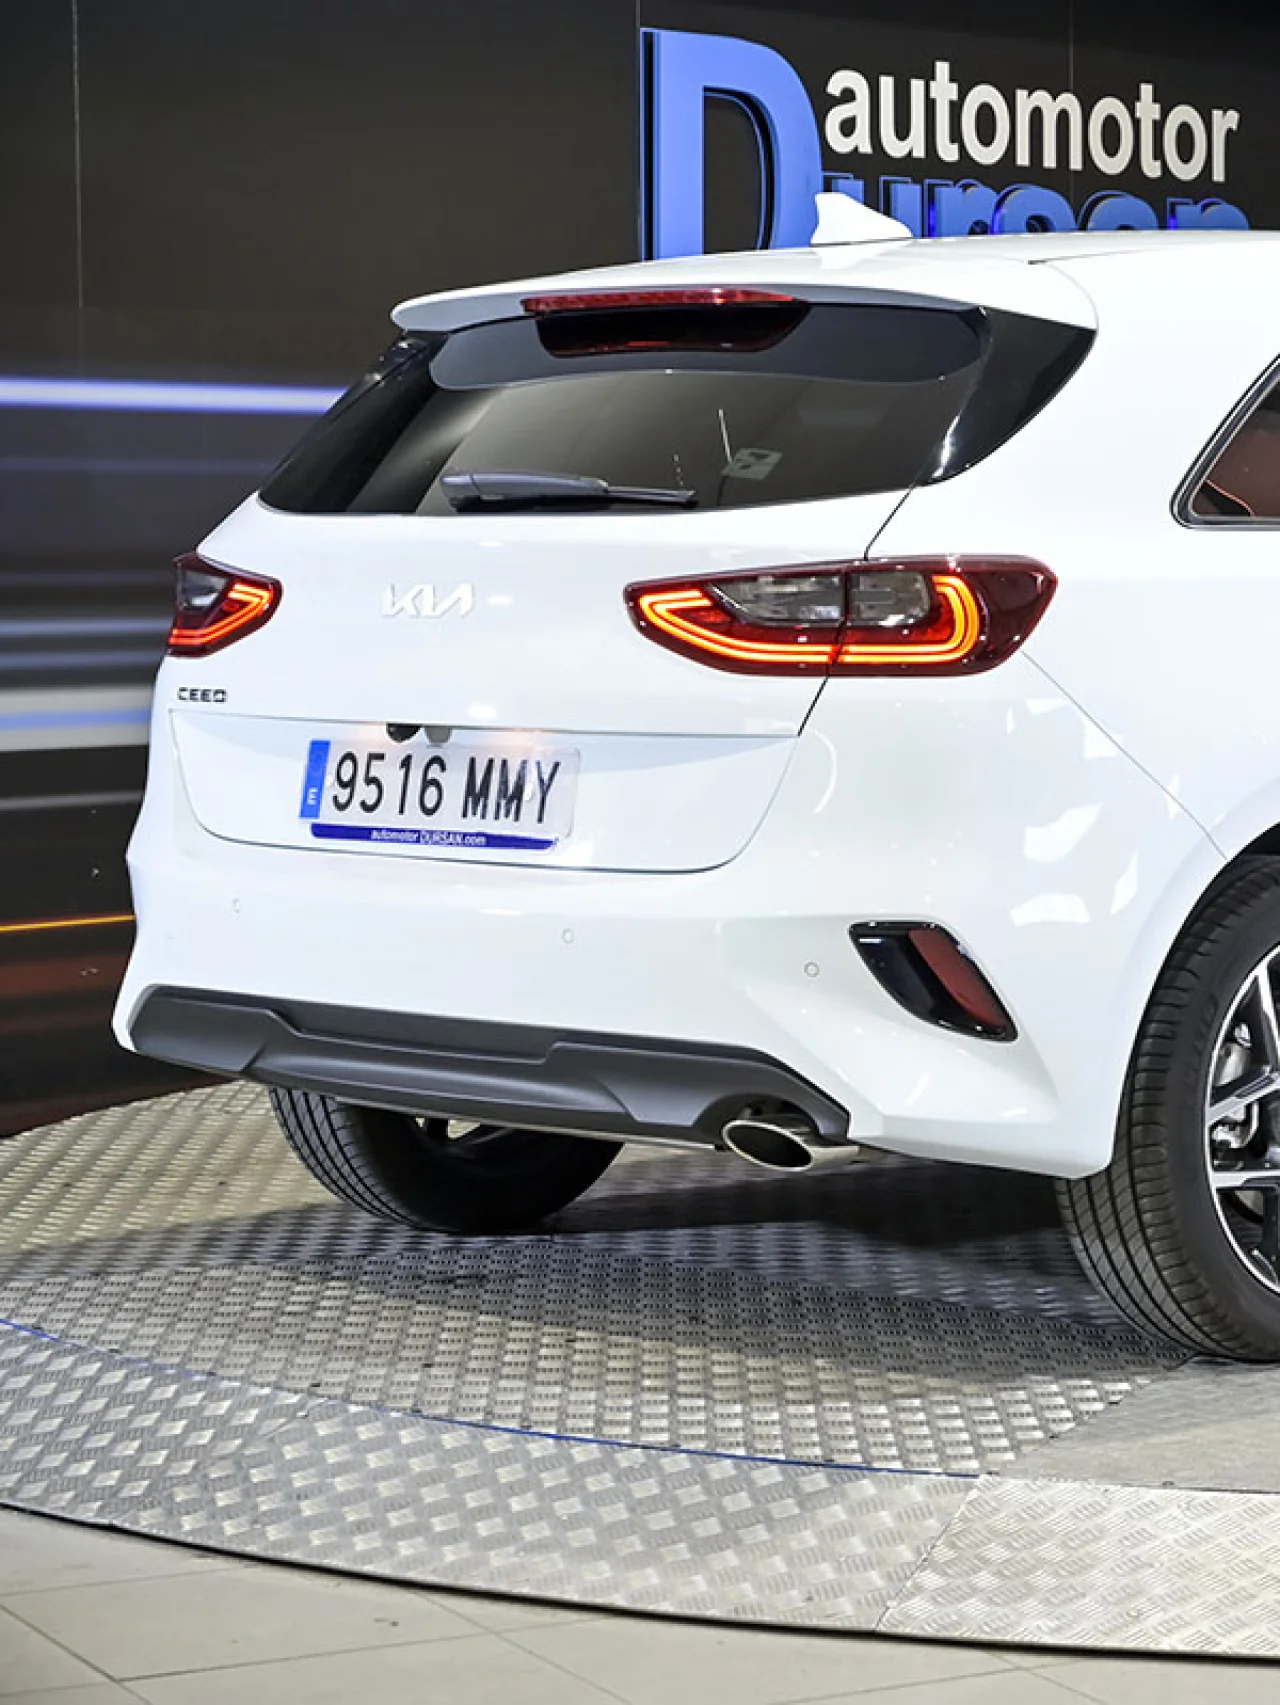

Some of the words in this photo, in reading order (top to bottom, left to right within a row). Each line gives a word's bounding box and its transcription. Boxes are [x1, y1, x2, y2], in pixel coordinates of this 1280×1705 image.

[824, 60, 1241, 183] automotor
[332, 750, 447, 818] 9516
[461, 756, 561, 824] MMY
